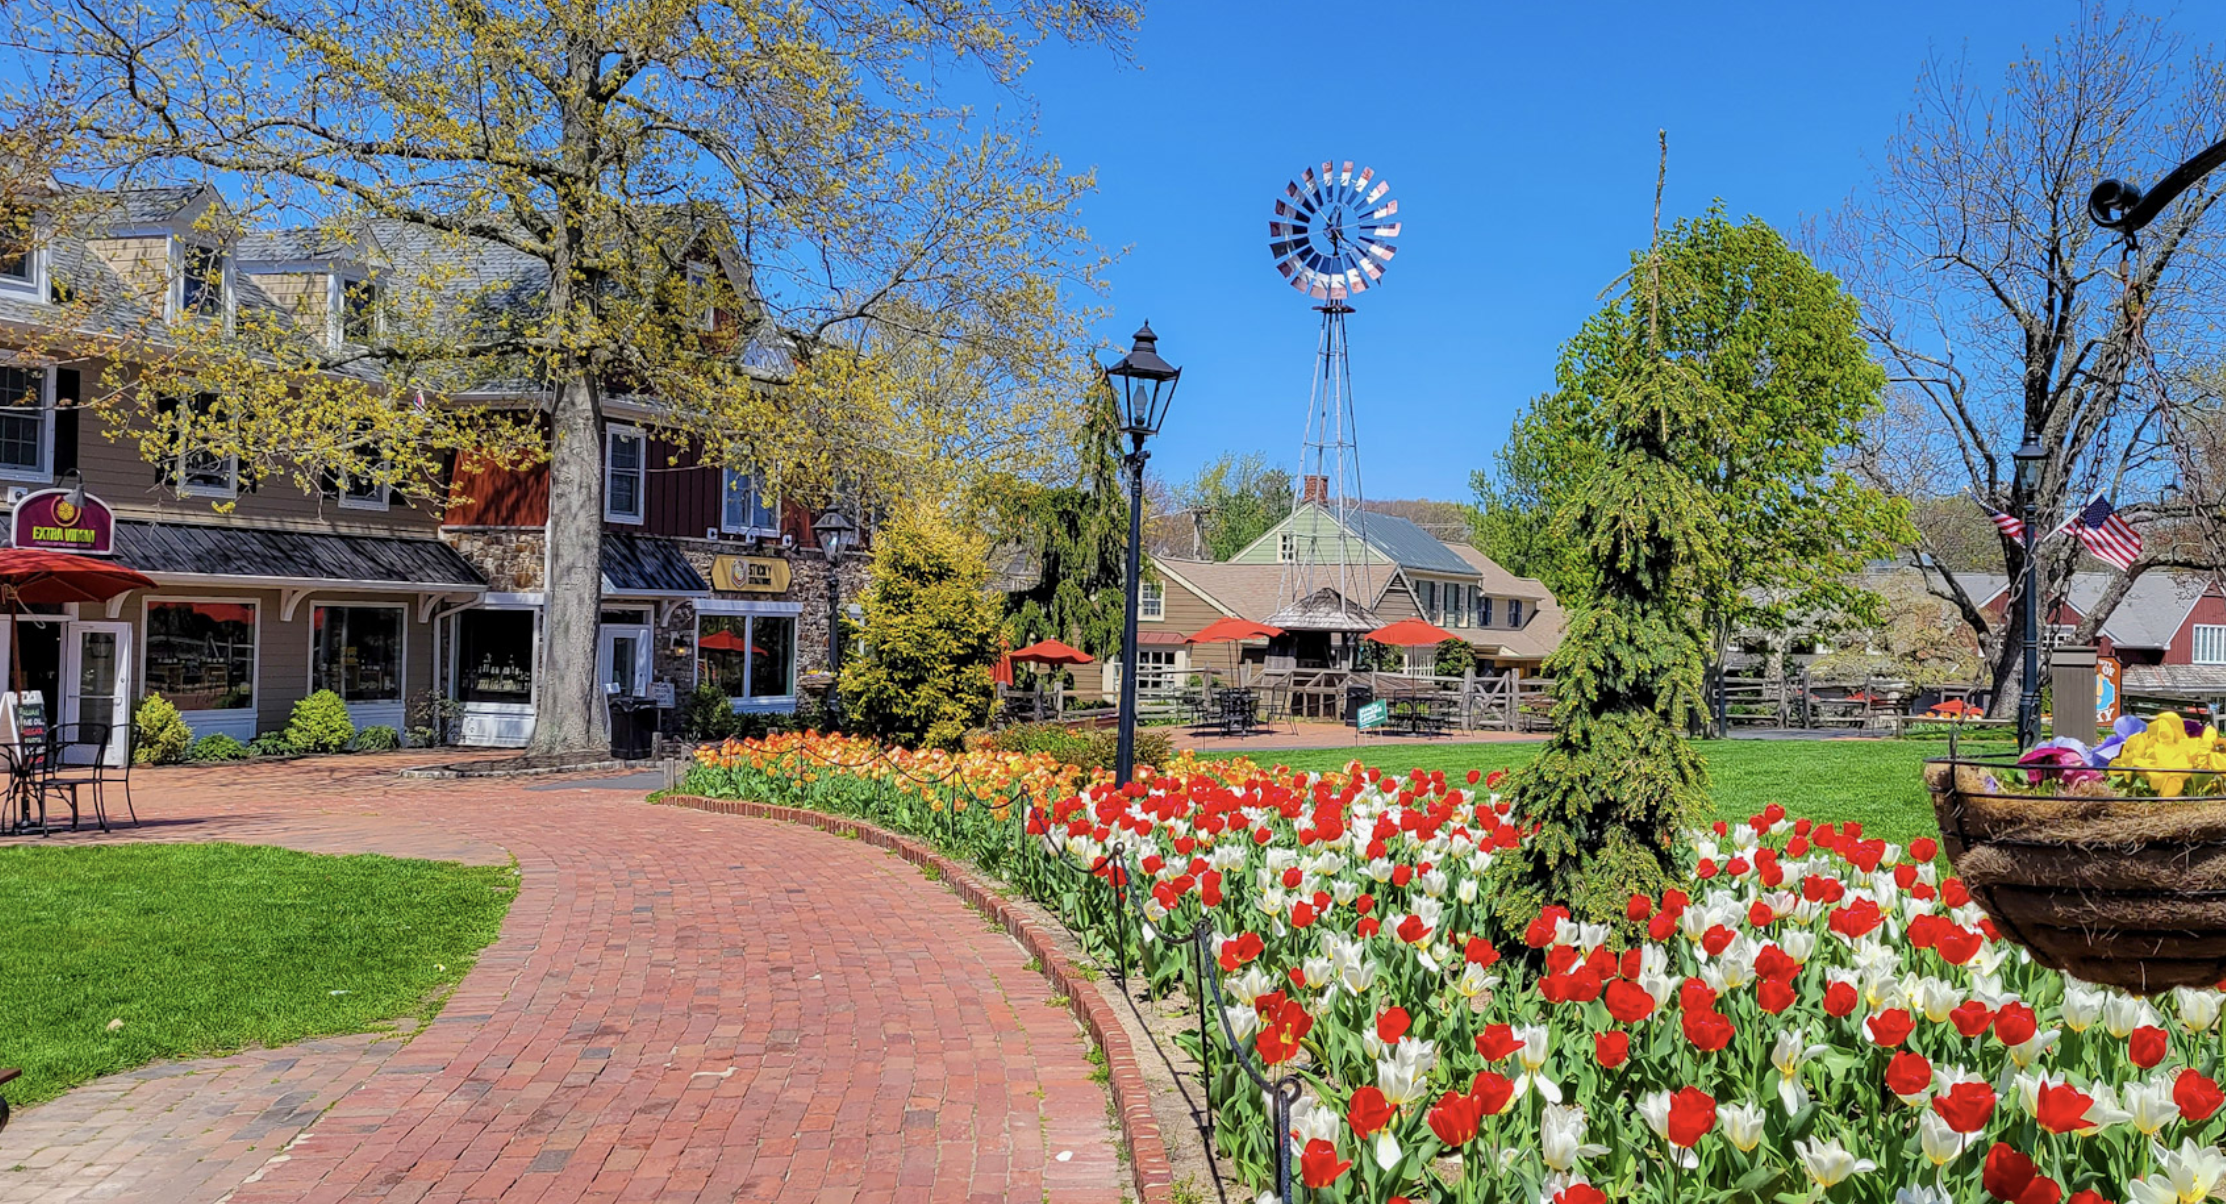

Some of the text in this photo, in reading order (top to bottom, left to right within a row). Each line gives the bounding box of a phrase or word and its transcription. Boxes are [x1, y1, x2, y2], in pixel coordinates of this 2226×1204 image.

[33, 526, 95, 543] EXTRA VIRGIN
[749, 564, 772, 576] STICKY
